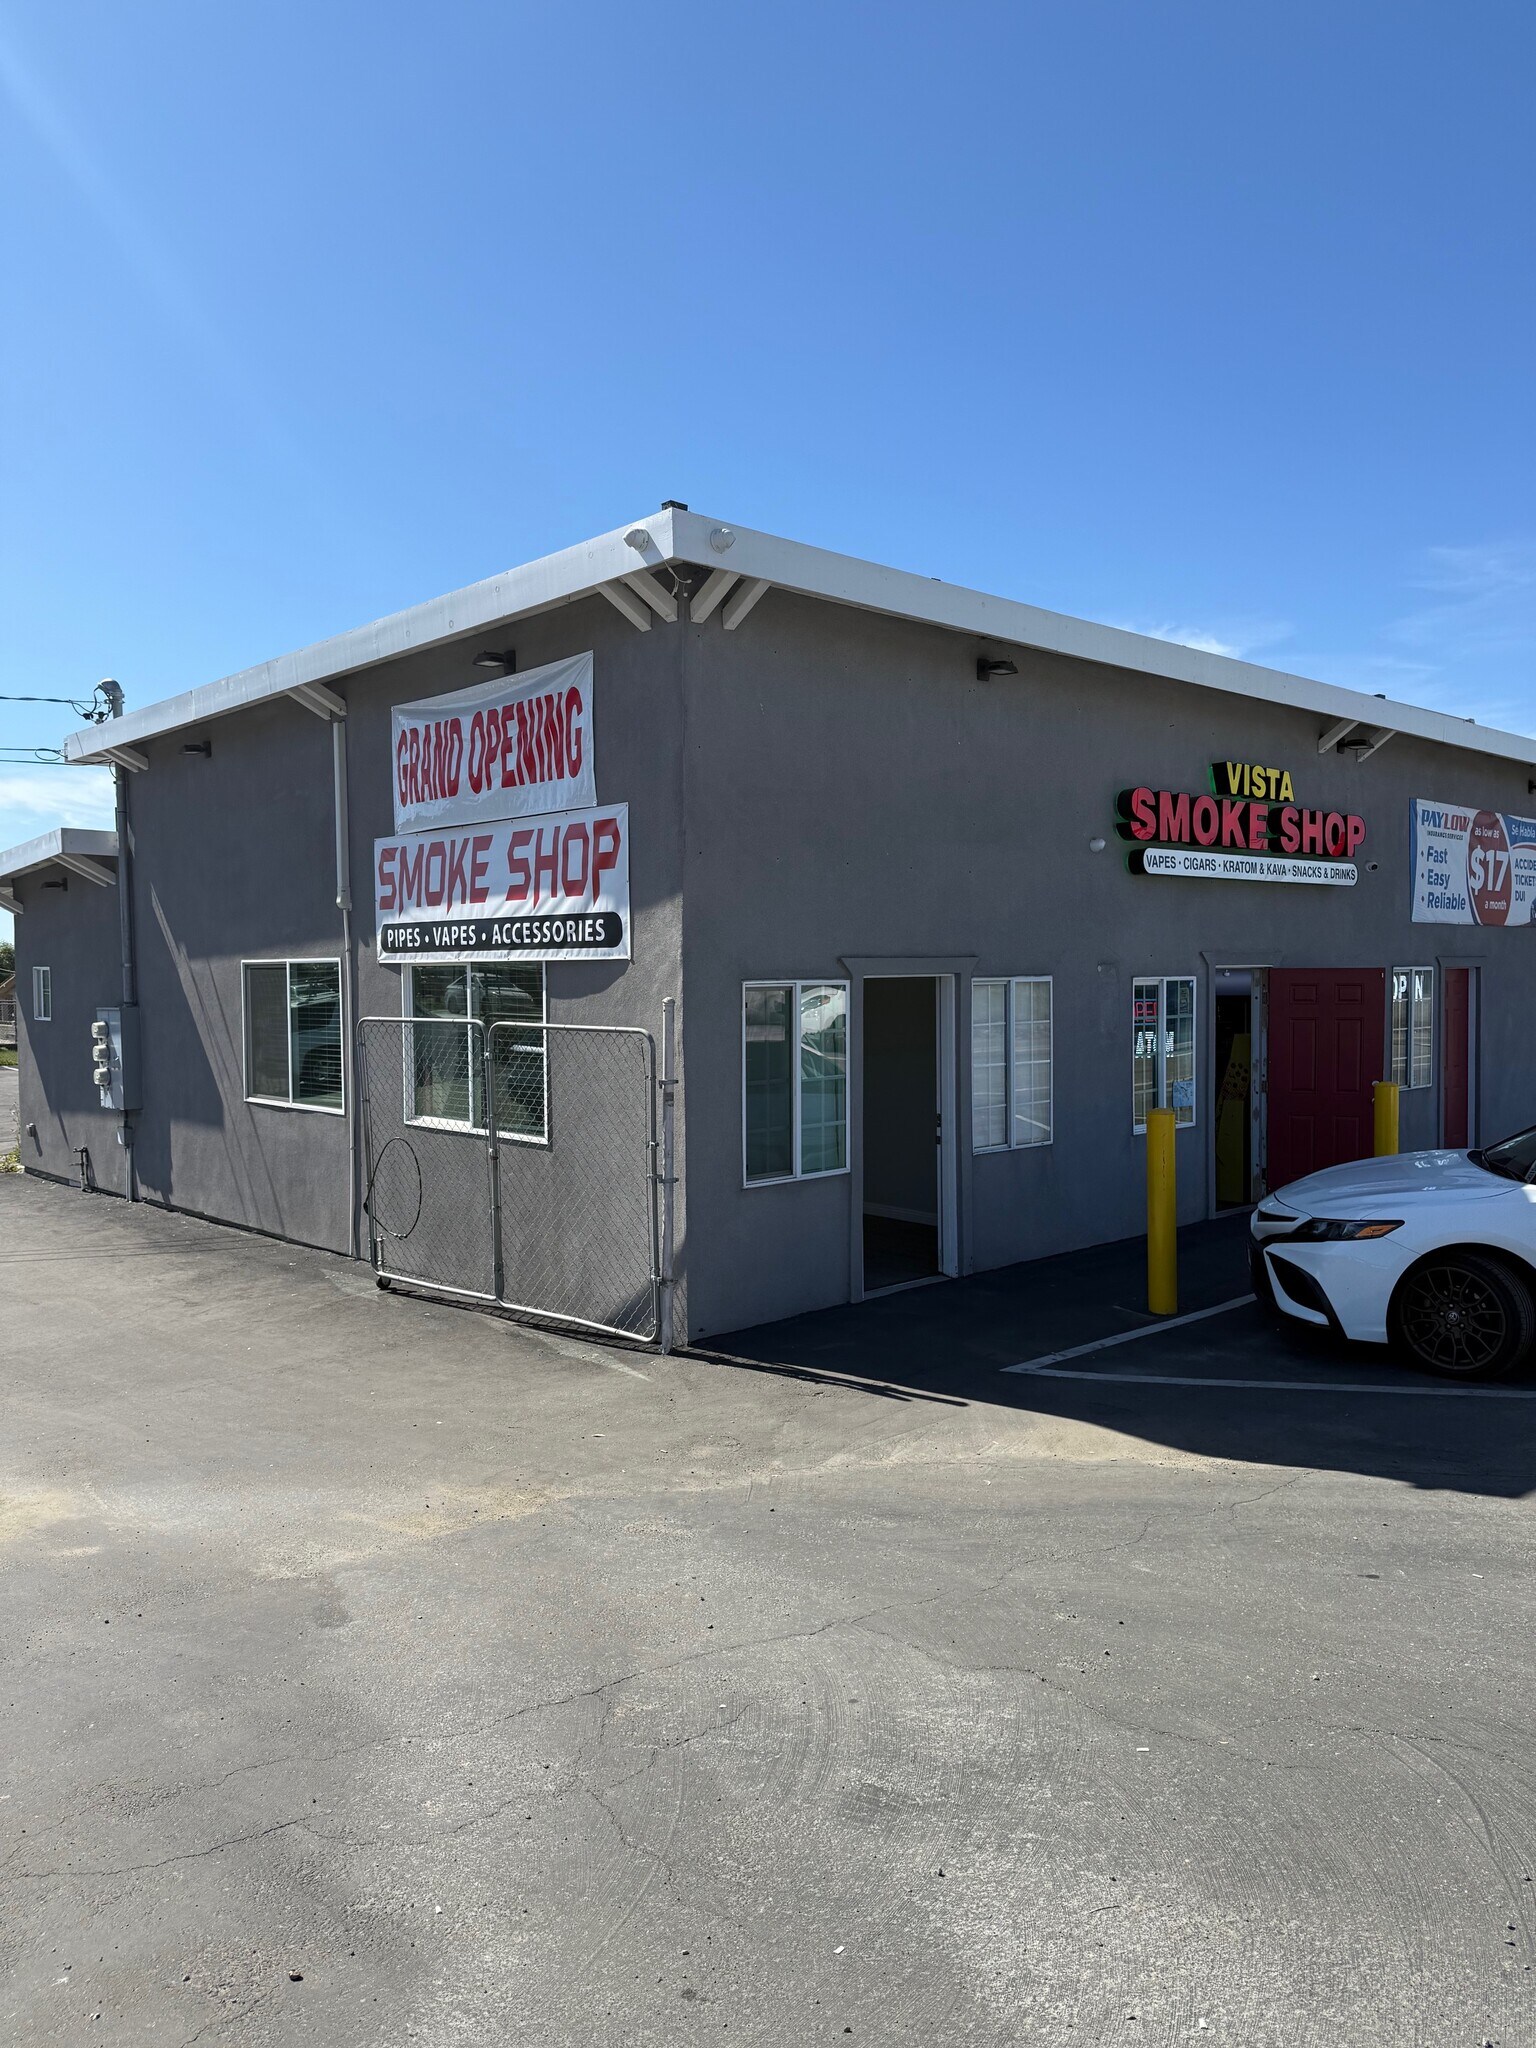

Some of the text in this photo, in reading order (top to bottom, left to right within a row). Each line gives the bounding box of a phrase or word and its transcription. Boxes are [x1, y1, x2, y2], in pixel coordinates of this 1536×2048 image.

[397, 686, 583, 807] GRAND OPENING
[1226, 760, 1295, 802] VISTA
[1130, 786, 1366, 857] SMOKE SHOP
[1421, 808, 1470, 832] PAYLOW
[1511, 824, 1519, 836] Se
[378, 818, 621, 918] SMOKE SHOP
[1146, 854, 1356, 881] VAPES CIGARS KRATOM & KAVA SNACKS & DRINKS
[1426, 845, 1448, 864] Fast
[1427, 868, 1450, 890] Easy
[1470, 844, 1510, 896] $17
[1427, 892, 1466, 910] Reliable
[1514, 890, 1526, 902] DUI
[387, 918, 606, 947] PIPES VAPES ACCESSORIES
[1393, 975, 1424, 1002] OPN
